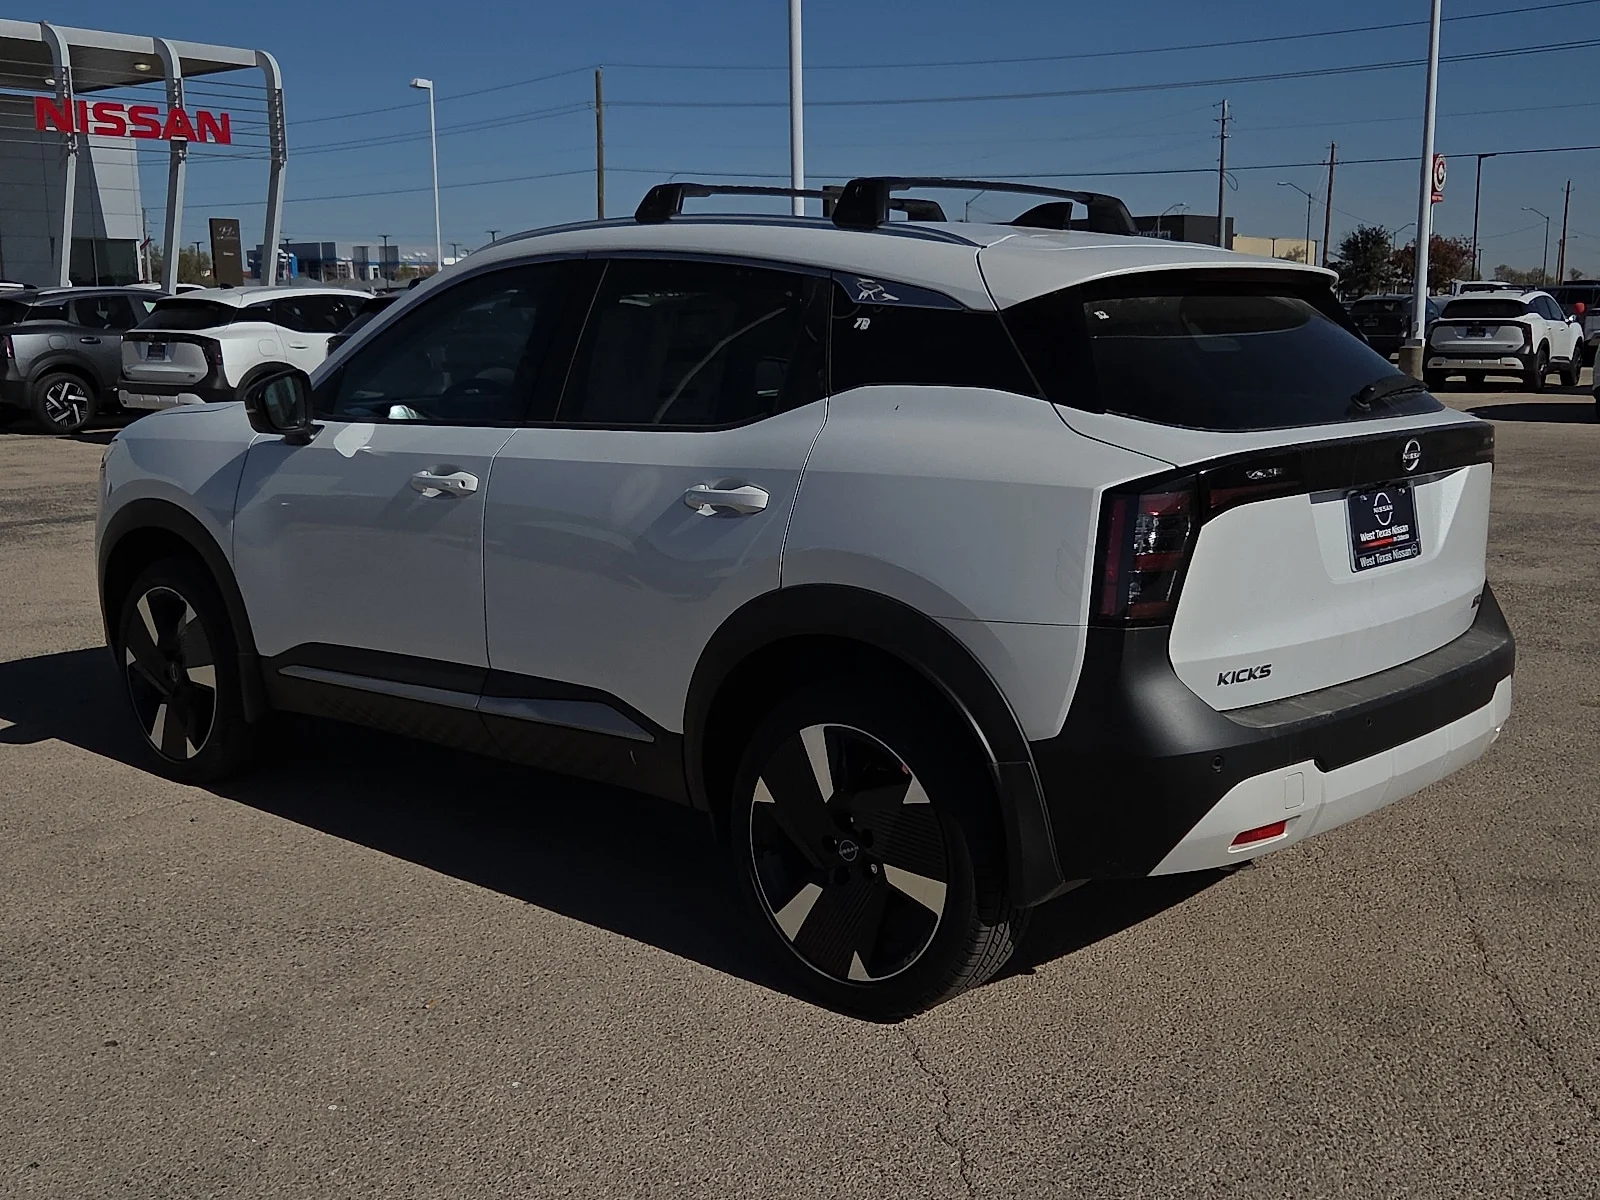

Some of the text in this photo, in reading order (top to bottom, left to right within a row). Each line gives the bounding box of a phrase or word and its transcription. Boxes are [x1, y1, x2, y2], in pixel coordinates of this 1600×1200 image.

[34, 96, 231, 144] NISSAN
[1373, 504, 1393, 514] NISSAN
[1360, 531, 1375, 542] West
[1375, 528, 1391, 539] Texas
[1391, 524, 1409, 535] Nissan
[1360, 548, 1412, 568] West Texas Nissan
[1217, 663, 1272, 687] KICKS
